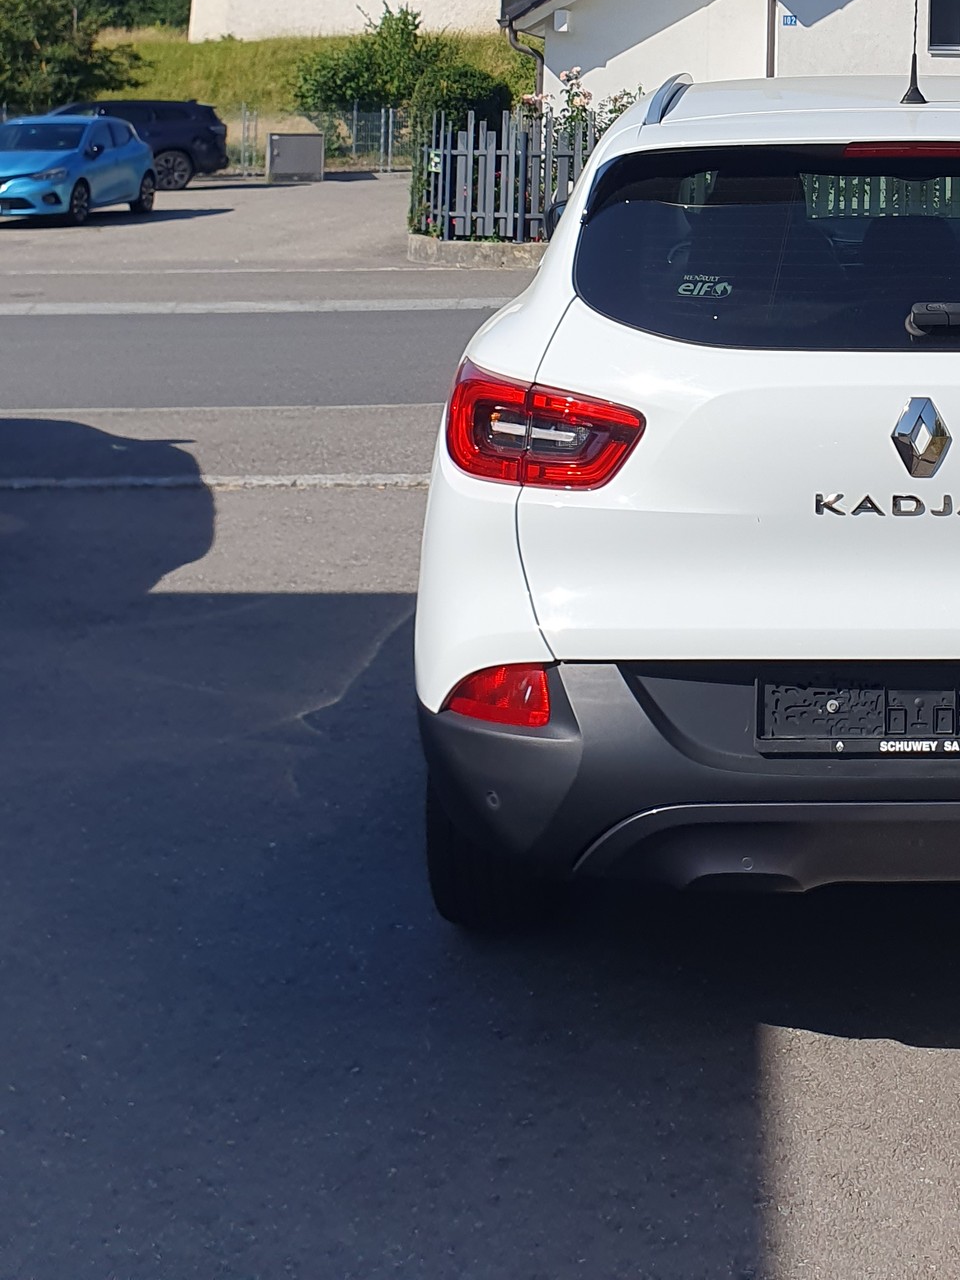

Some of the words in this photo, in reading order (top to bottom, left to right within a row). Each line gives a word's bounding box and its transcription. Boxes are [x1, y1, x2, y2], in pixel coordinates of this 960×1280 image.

[784, 16, 796, 25] 102
[683, 274, 720, 282] RENAULT
[678, 282, 714, 296] elf
[879, 740, 938, 752] SCHUWEY
[943, 740, 960, 752] SA
